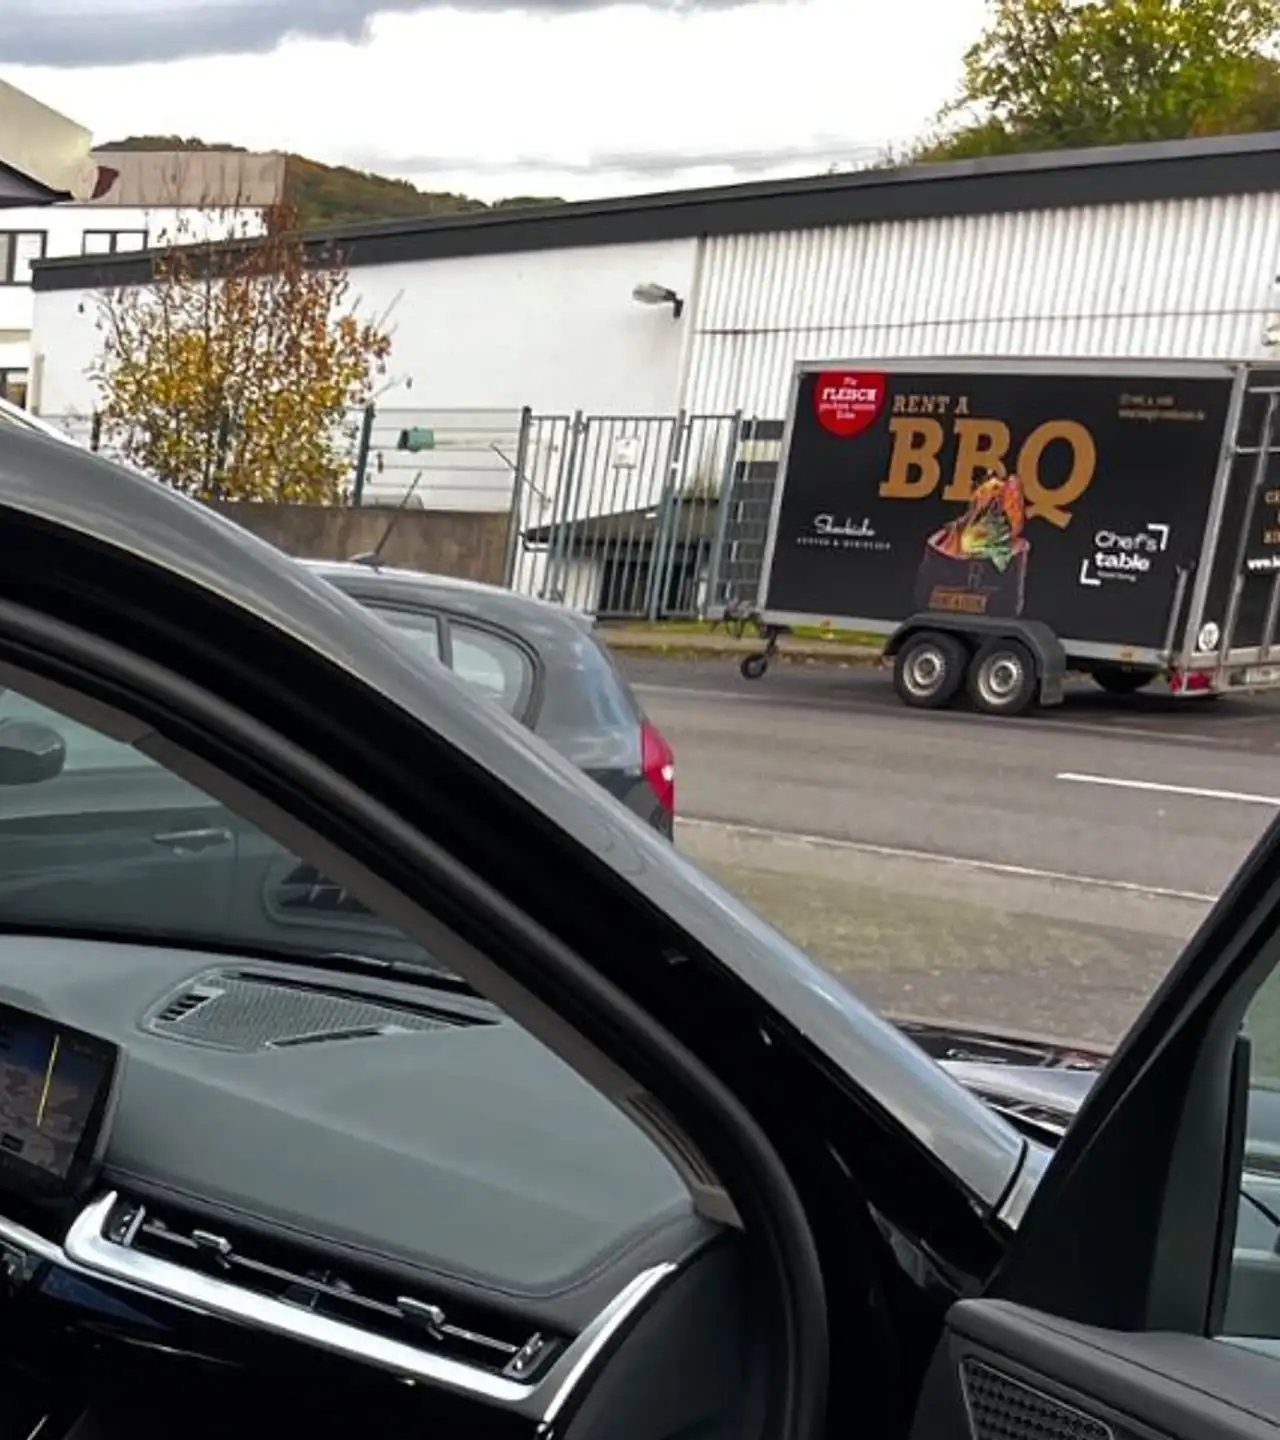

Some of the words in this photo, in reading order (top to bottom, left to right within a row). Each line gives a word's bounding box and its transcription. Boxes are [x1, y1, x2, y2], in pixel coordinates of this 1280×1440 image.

[892, 395, 950, 413] RENT
[954, 395, 969, 414] A
[878, 416, 1097, 529] BBQ
[1095, 552, 1150, 572] table
